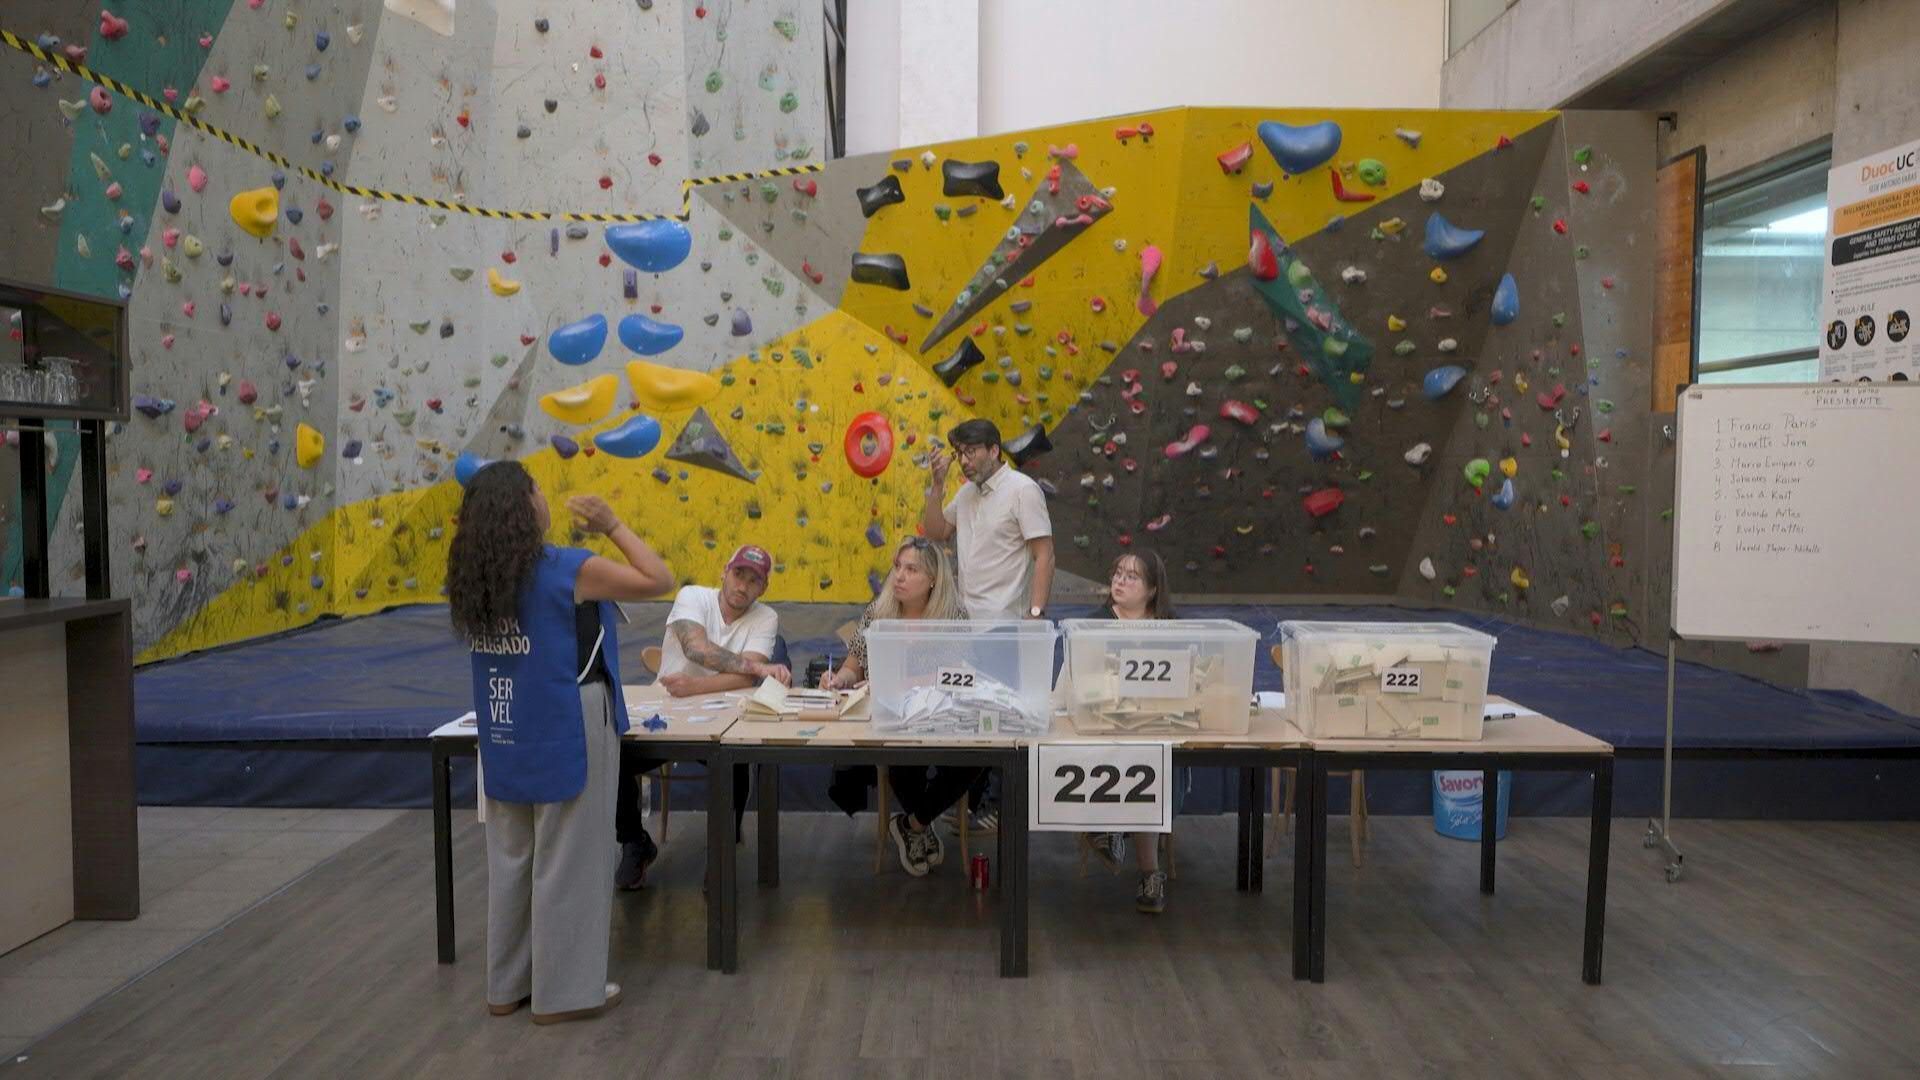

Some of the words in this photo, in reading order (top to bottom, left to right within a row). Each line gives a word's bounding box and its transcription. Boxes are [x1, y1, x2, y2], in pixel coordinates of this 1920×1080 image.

[1849, 233, 1873, 245] GENERAL
[1873, 228, 1894, 239] SAFETY
[1864, 239, 1877, 249] AND
[1878, 235, 1896, 246] TERMS
[1906, 230, 1917, 239] USE
[1860, 302, 1876, 313] RULE
[941, 671, 975, 687] 222
[1124, 659, 1172, 682] 222
[1385, 672, 1419, 687] 222
[489, 677, 513, 700] SER
[489, 701, 513, 724] VEL
[1053, 764, 1157, 803] 222
